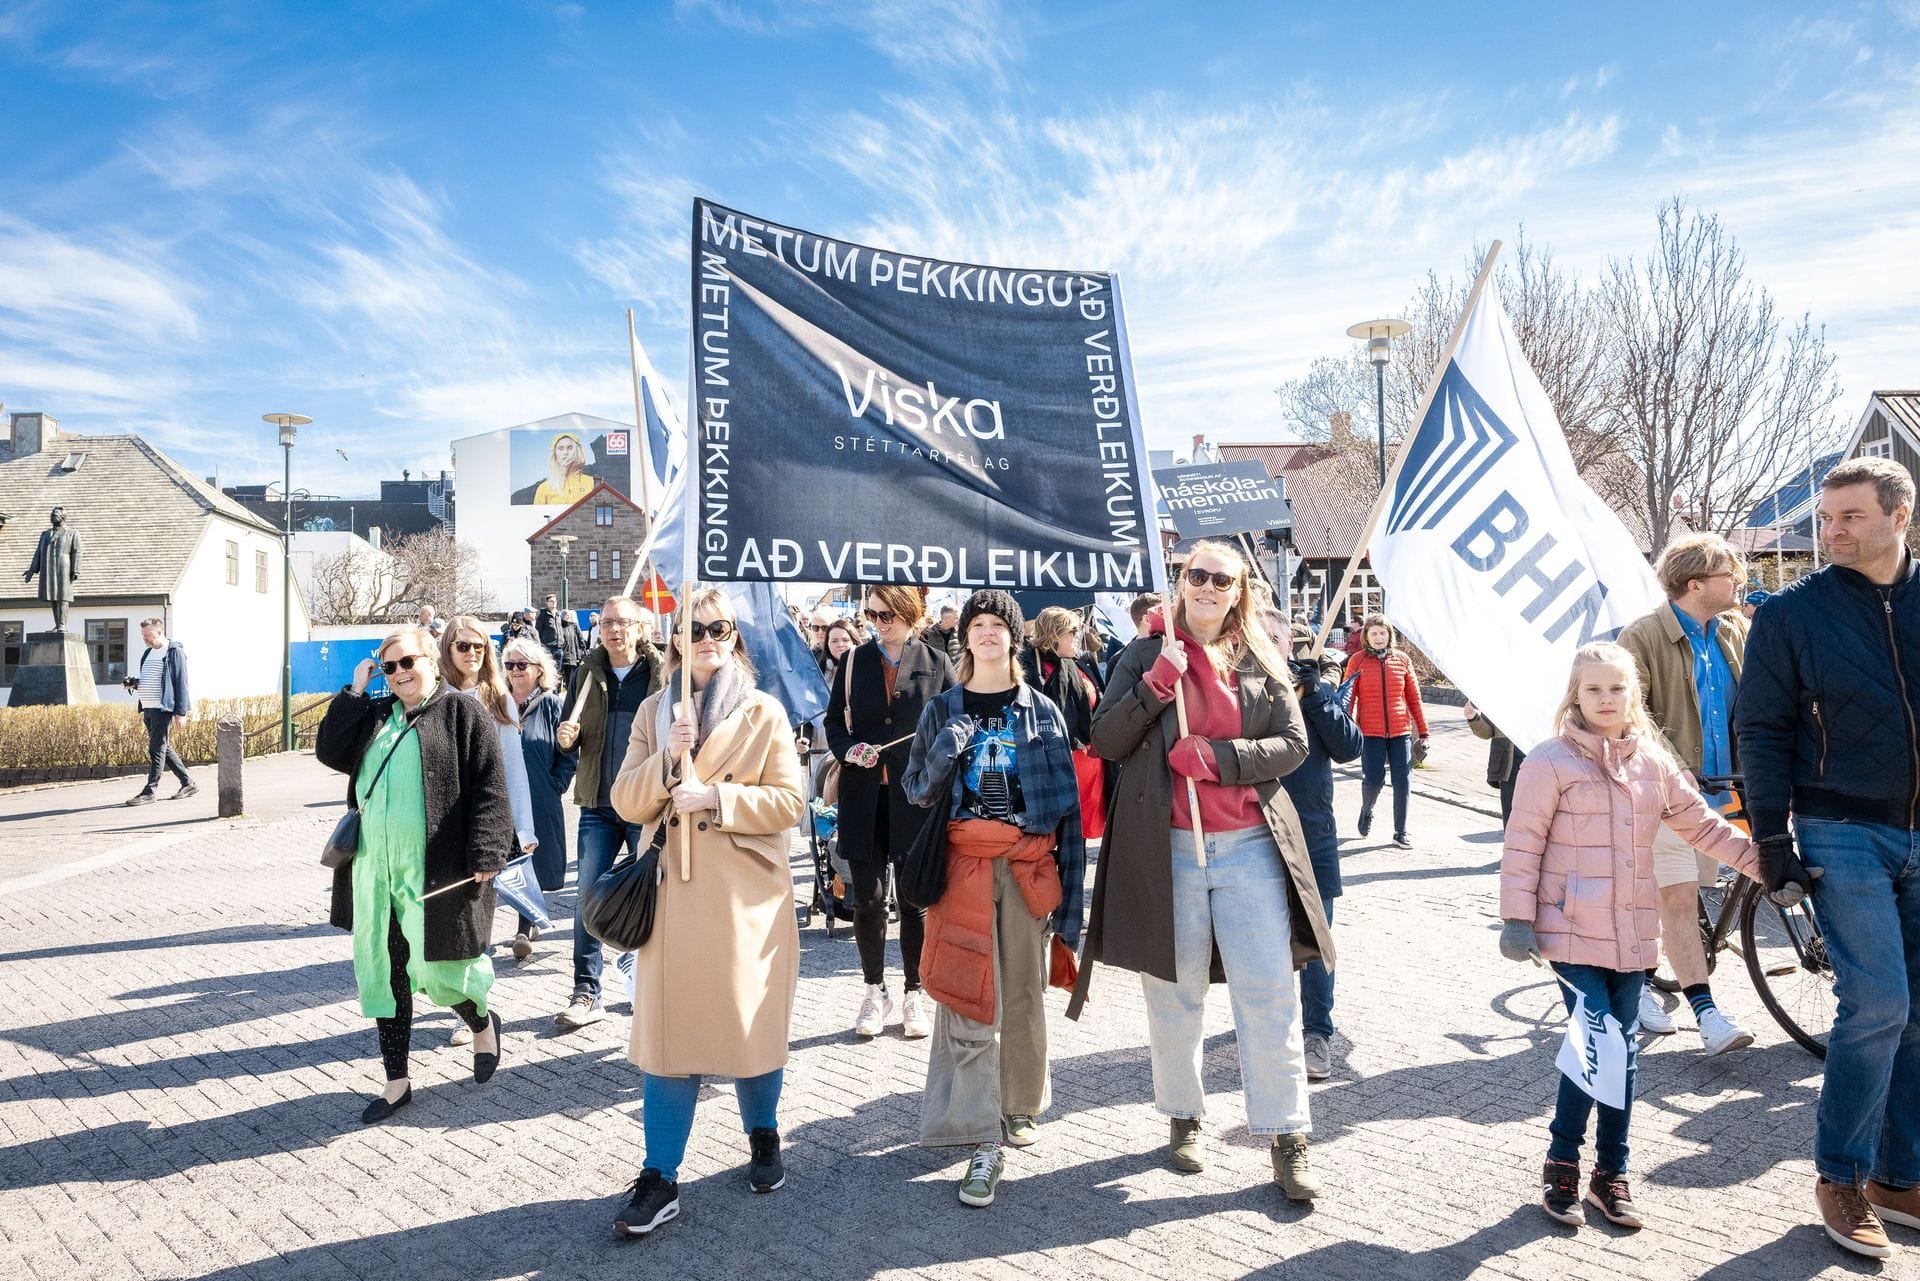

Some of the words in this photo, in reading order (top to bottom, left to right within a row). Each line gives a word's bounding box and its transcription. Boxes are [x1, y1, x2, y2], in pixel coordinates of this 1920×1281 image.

[701, 205, 860, 283] METUM
[870, 251, 1074, 307] ÞEKKINGU
[701, 251, 730, 386] METUM
[1079, 276, 1106, 321] AÐ
[832, 361, 1006, 440] Viska
[609, 435, 625, 448] 66
[833, 435, 1010, 470] STÉTTARFÉLAG
[1084, 334, 1141, 547] VERÐLEIKUM
[703, 398, 730, 577] ÞEKKINGU
[1161, 477, 1266, 498] háskóla-
[1167, 487, 1279, 510] menntun
[1265, 518, 1291, 526] Viska
[735, 537, 804, 578] AÐ
[819, 541, 1144, 588] VERÐLEIKUM
